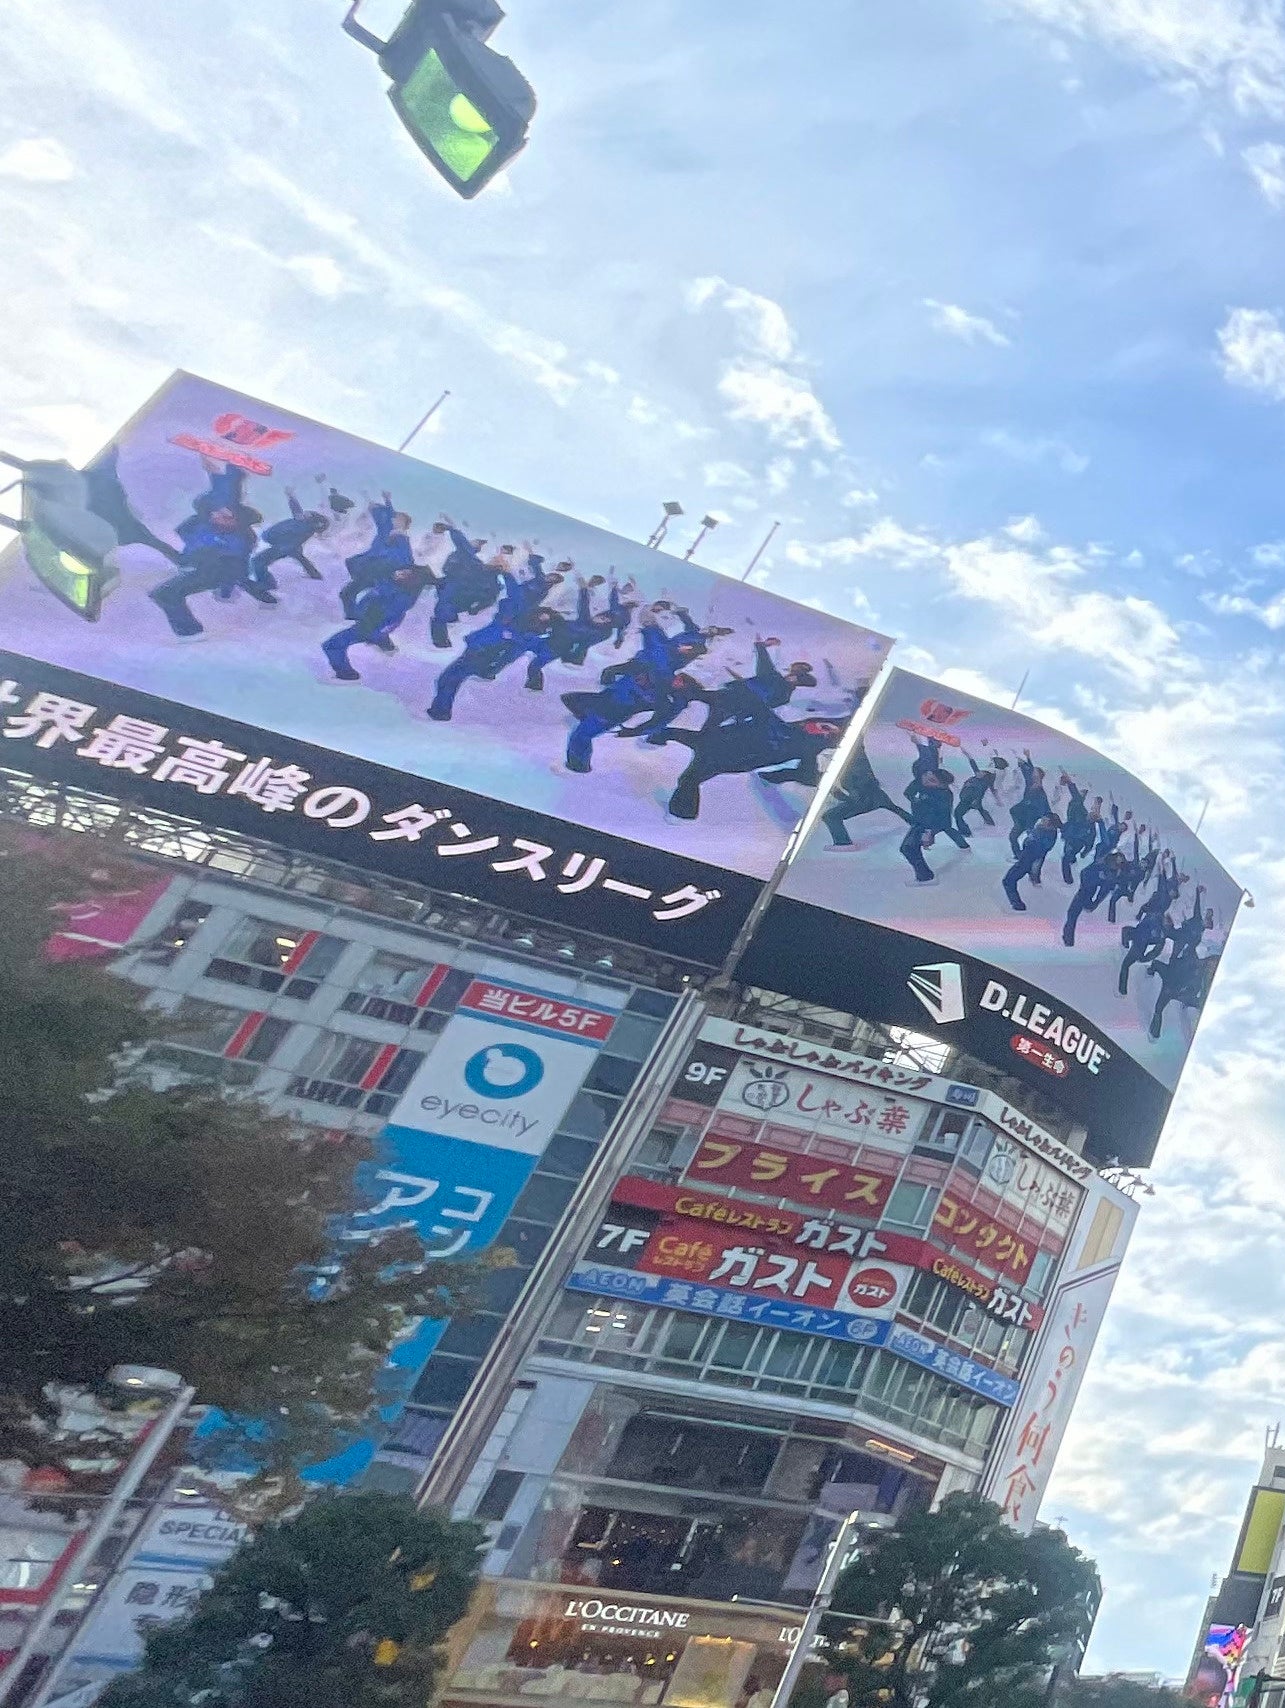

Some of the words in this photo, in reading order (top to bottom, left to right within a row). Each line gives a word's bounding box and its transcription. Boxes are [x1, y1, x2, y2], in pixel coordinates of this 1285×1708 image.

[0, 680, 722, 921] 界最高峰のダンスリーグ
[479, 989, 601, 1032] 当ビル5F
[979, 979, 1106, 1075] D.LEAGUE
[685, 1062, 728, 1085] 9F
[420, 1094, 539, 1138] eyecity
[797, 1083, 910, 1134] しゃぶ葉
[597, 1224, 650, 1252] 7F
[795, 1219, 888, 1258] ガスト
[933, 1196, 1028, 1270] コンタクト
[709, 1247, 832, 1297] ガスト
[853, 1282, 890, 1299] ガスト
[661, 1282, 841, 1331] 英会話イーオン
[987, 1287, 1033, 1326] ガスト
[565, 1600, 690, 1628] L'OCCITANE
[600, 1625, 661, 1638] PROVENCE
